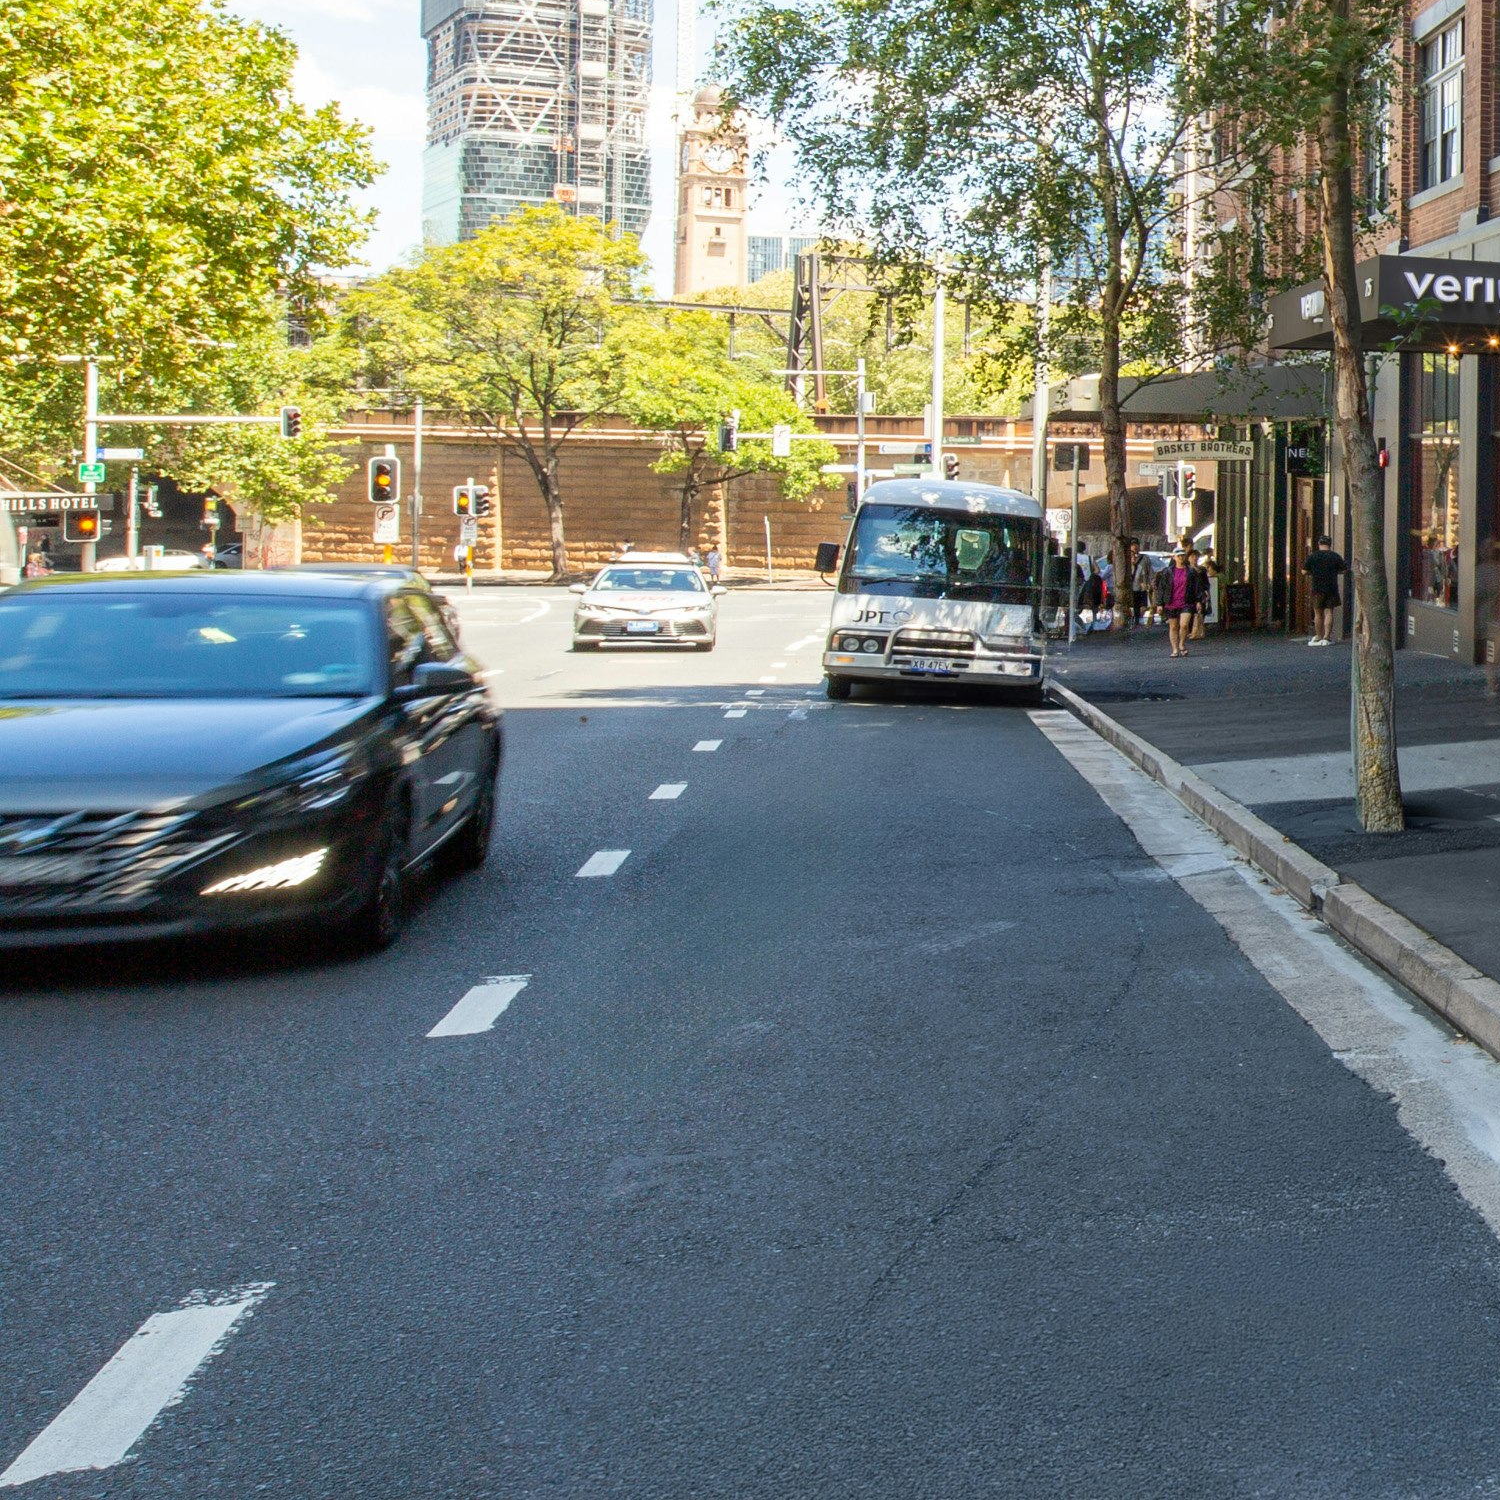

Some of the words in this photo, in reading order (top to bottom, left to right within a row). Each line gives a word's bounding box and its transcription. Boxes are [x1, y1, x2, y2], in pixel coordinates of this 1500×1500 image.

[1157, 443, 1196, 456] BASKET
[1200, 442, 1252, 456] BROTHERS
[1, 498, 47, 510] HILLS
[50, 497, 98, 510] HOTEL
[852, 610, 891, 624] JPT
